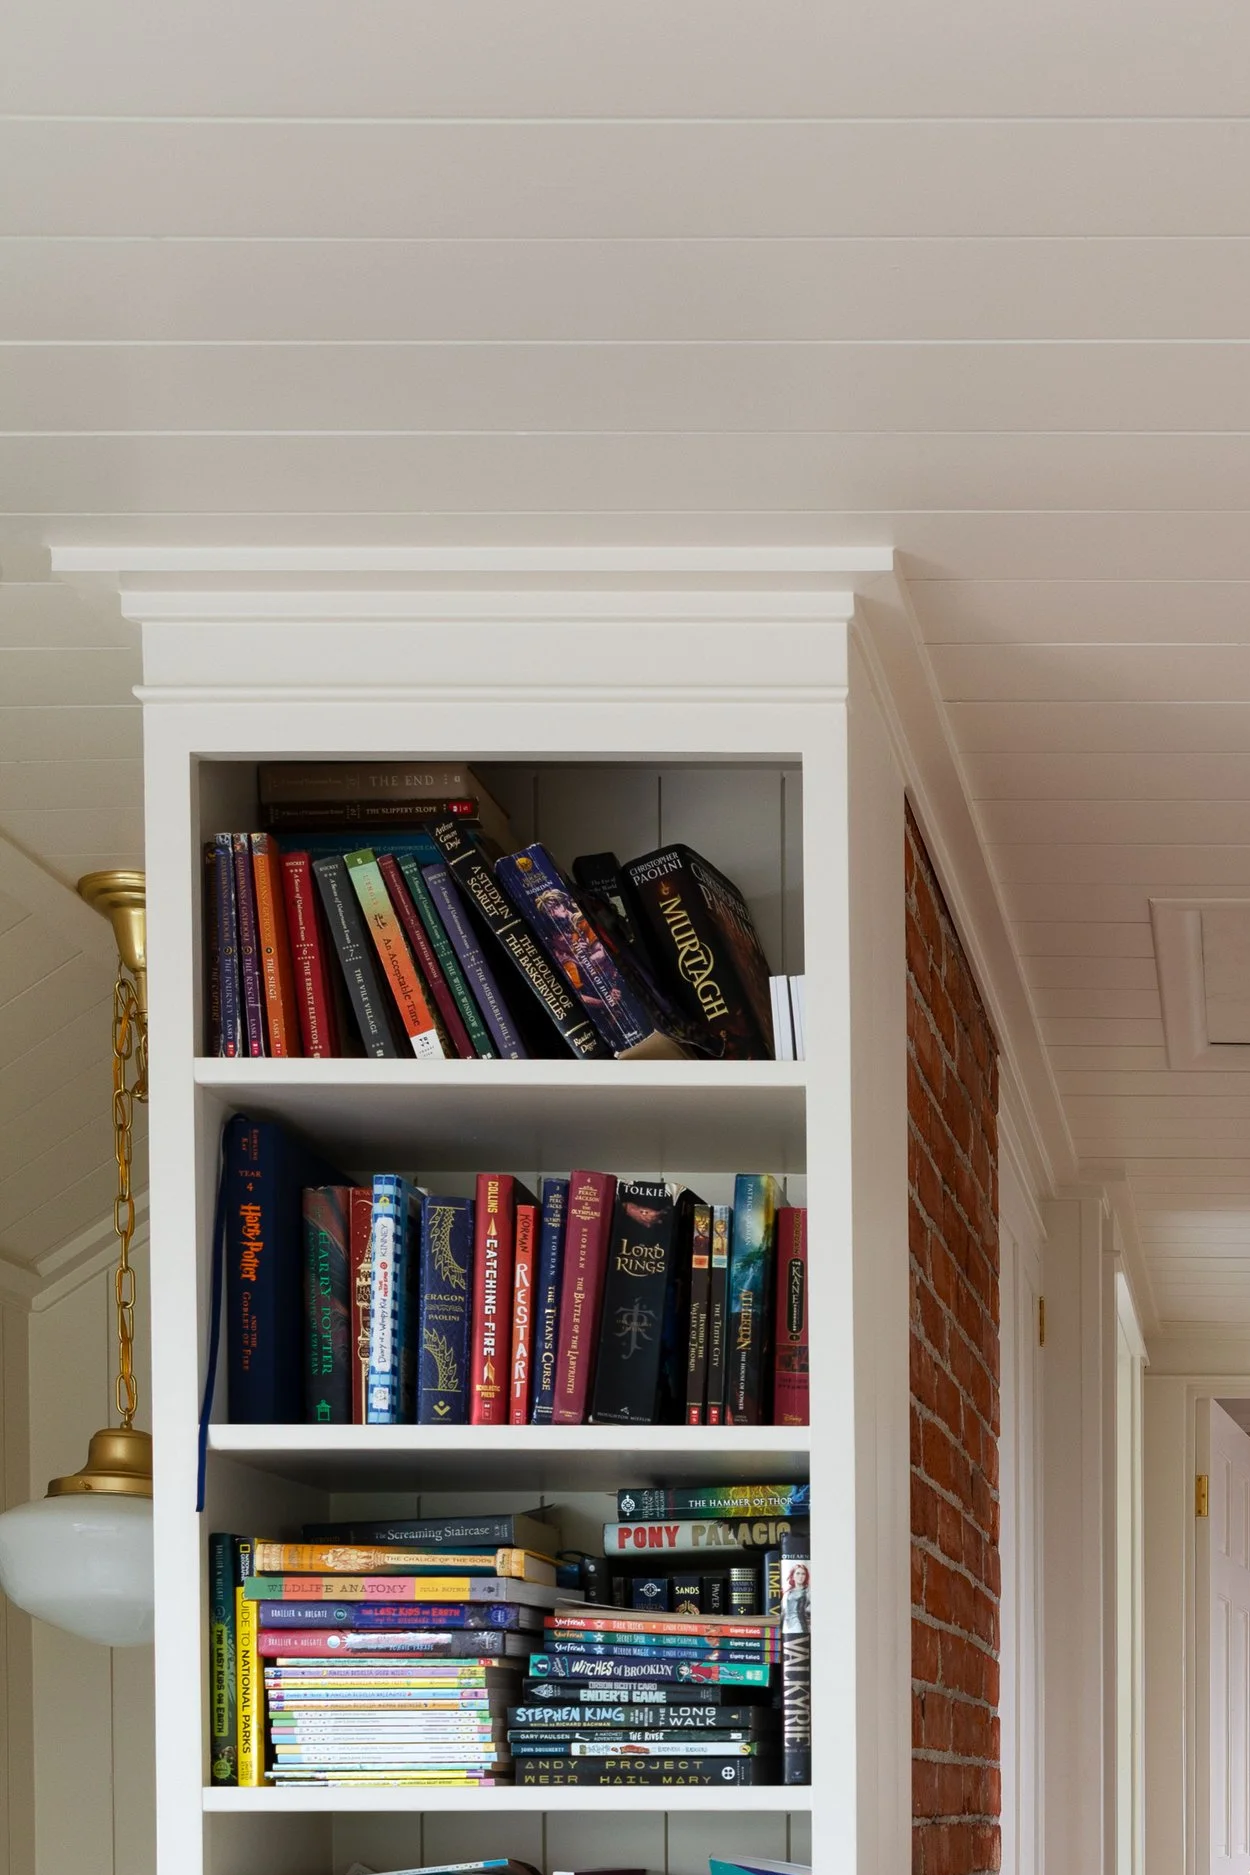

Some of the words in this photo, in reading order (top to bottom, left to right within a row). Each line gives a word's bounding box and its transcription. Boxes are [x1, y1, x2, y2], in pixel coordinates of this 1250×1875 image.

[369, 775, 398, 786] THE
[405, 775, 434, 786] END
[470, 863, 482, 874] A
[630, 852, 679, 877] CHRISTOPHER
[633, 858, 683, 886] PAOLINI
[463, 876, 502, 918] SCARLET
[475, 871, 506, 907] STUDY
[526, 881, 553, 896] RIORDAN
[498, 904, 512, 920] IN
[382, 937, 393, 951] An
[660, 894, 728, 1021] MURTAGH
[386, 950, 415, 1002] Acceptable
[504, 933, 525, 957] THE
[518, 955, 567, 1021] BASKERVILLES
[517, 933, 538, 957] THE
[531, 954, 565, 996] HOUND
[557, 993, 573, 1011] OF
[405, 1001, 420, 1027] Time
[487, 1181, 498, 1212] COLLINS
[624, 1184, 671, 1198] TOLKIEN
[239, 1202, 261, 1242] Harry
[517, 1214, 532, 1253] KORMAN
[379, 1223, 388, 1256] KINNEY
[578, 1228, 587, 1268] RIORDAN
[620, 1238, 664, 1258] LORD
[240, 1240, 264, 1282] Potter
[315, 1232, 332, 1298] HARRY
[616, 1257, 665, 1276] RINGS
[483, 1238, 498, 1314] CATCHING
[424, 1294, 464, 1302] ERAGON
[547, 1286, 555, 1302] THE
[428, 1314, 460, 1322] PAOLINI
[513, 1263, 530, 1398] RESTART
[541, 1307, 556, 1348] TITAN'S
[698, 1313, 706, 1343] BEYOND
[735, 1289, 753, 1350] ATHERTON
[317, 1306, 336, 1374] POTTER
[483, 1322, 495, 1356] FIRE
[539, 1351, 554, 1390] CURSE
[688, 1500, 706, 1508] THE
[710, 1499, 751, 1507] HAMMER
[768, 1497, 794, 1505] THOR
[618, 1525, 680, 1549] PONY
[692, 1522, 792, 1546] PALACIO
[268, 1584, 334, 1594] WILDLIFE
[340, 1584, 407, 1594] ANATOMY
[675, 1586, 700, 1595] SANDS
[767, 1562, 781, 1598] TIME
[711, 1583, 719, 1608] PAVER
[242, 1632, 248, 1646] TO
[241, 1650, 250, 1710] NATIONAL
[572, 1660, 614, 1676] WITCHES
[614, 1664, 622, 1676] of
[624, 1664, 673, 1676] BROOKLYN
[580, 1690, 629, 1702] ENDER'S
[632, 1691, 666, 1703] GAME
[783, 1634, 809, 1752] VALKYRIE
[516, 1707, 580, 1722] STEPHEN
[585, 1706, 625, 1722] KING
[670, 1707, 716, 1716] LONG
[670, 1718, 716, 1726] WALK
[242, 1714, 250, 1753] PARKS
[525, 1761, 578, 1770] ANDY
[605, 1761, 704, 1770] PROJECT
[524, 1775, 578, 1784] WEIR
